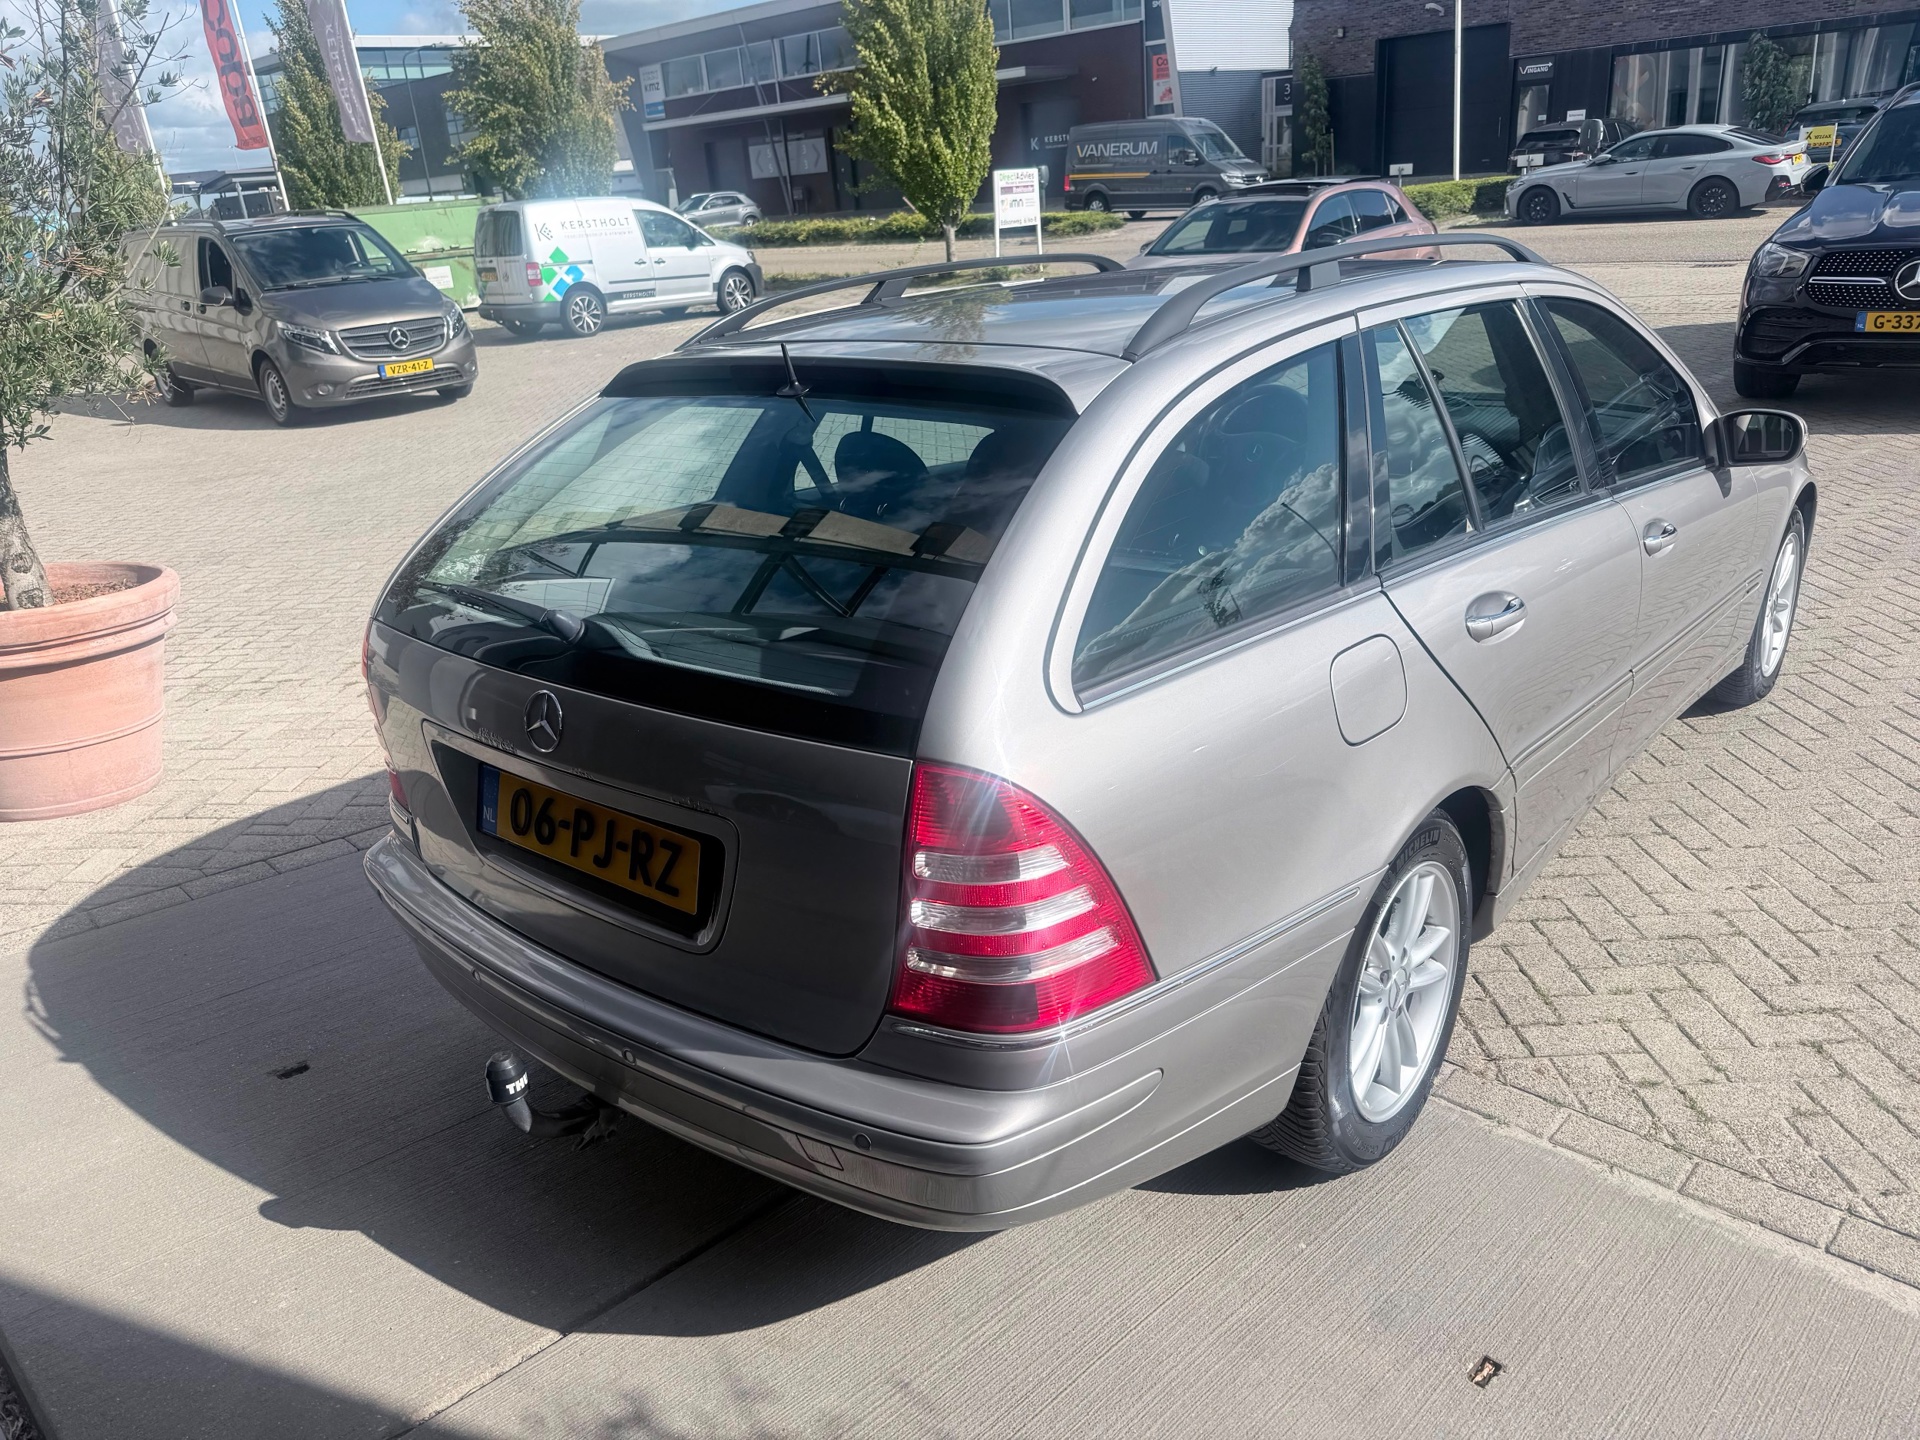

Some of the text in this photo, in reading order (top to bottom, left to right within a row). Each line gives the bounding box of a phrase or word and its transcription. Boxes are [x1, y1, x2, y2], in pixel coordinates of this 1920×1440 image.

[1284, 83, 1291, 95] 3
[1076, 141, 1158, 158] VANERUM
[560, 217, 630, 231] KERSTHOLT
[390, 360, 430, 375] VZR-41-Z
[483, 804, 496, 824] NL
[510, 787, 683, 898] 06-PJ-RZ
